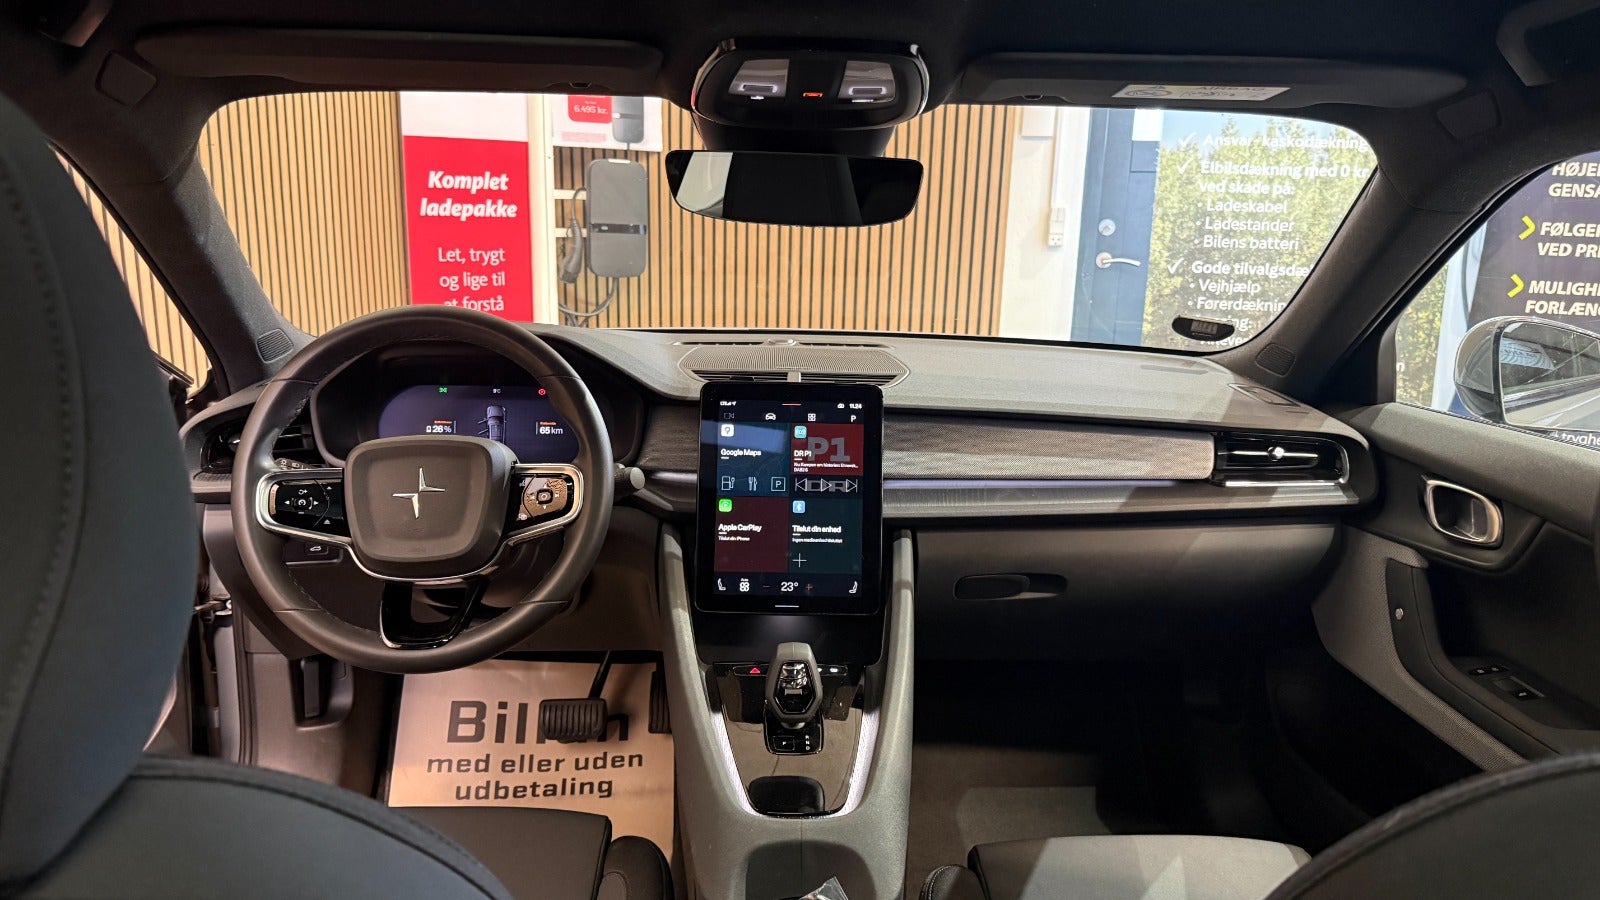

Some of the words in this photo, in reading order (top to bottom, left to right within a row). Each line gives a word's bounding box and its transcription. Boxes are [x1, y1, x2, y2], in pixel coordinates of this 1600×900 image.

[574, 105, 596, 113] 6.495
[1201, 161, 1301, 179] Elbilsdækning
[1305, 165, 1336, 178] med
[1341, 165, 1350, 177] 0
[1552, 161, 1600, 176] HØJE
[428, 171, 508, 194] Komplet
[1199, 181, 1225, 193] ved
[1228, 181, 1270, 195] skade
[1273, 182, 1295, 197] på:
[420, 198, 517, 221] ladepakke
[1207, 199, 1288, 213] Ladeskabel
[1205, 216, 1294, 232] Ladestander
[1540, 222, 1600, 237] FØLGE
[1203, 234, 1247, 248] Bilens
[1250, 236, 1299, 250] batteri
[1538, 242, 1573, 256] VED
[1575, 244, 1600, 258] PR
[438, 248, 466, 264] Let,
[470, 248, 505, 268] trygt
[1191, 260, 1231, 274] Gode
[439, 276, 460, 291] og
[463, 273, 488, 291] lige
[492, 272, 505, 287] til
[1199, 278, 1261, 295] Vejhjælp
[1528, 280, 1600, 296] MULIGH
[462, 295, 504, 312] forstå
[1525, 300, 1600, 316] FORLÆN
[551, 427, 563, 435] km
[721, 449, 743, 457] Google
[744, 448, 762, 456] Maps
[807, 436, 851, 461] P1
[718, 524, 737, 532] Apple
[737, 524, 762, 532] CarPlay
[780, 581, 799, 592] 23°
[447, 700, 629, 744] Biln
[427, 754, 491, 773] med
[500, 754, 565, 773] eller
[574, 751, 643, 771] uden
[455, 777, 613, 800] udbetaling
